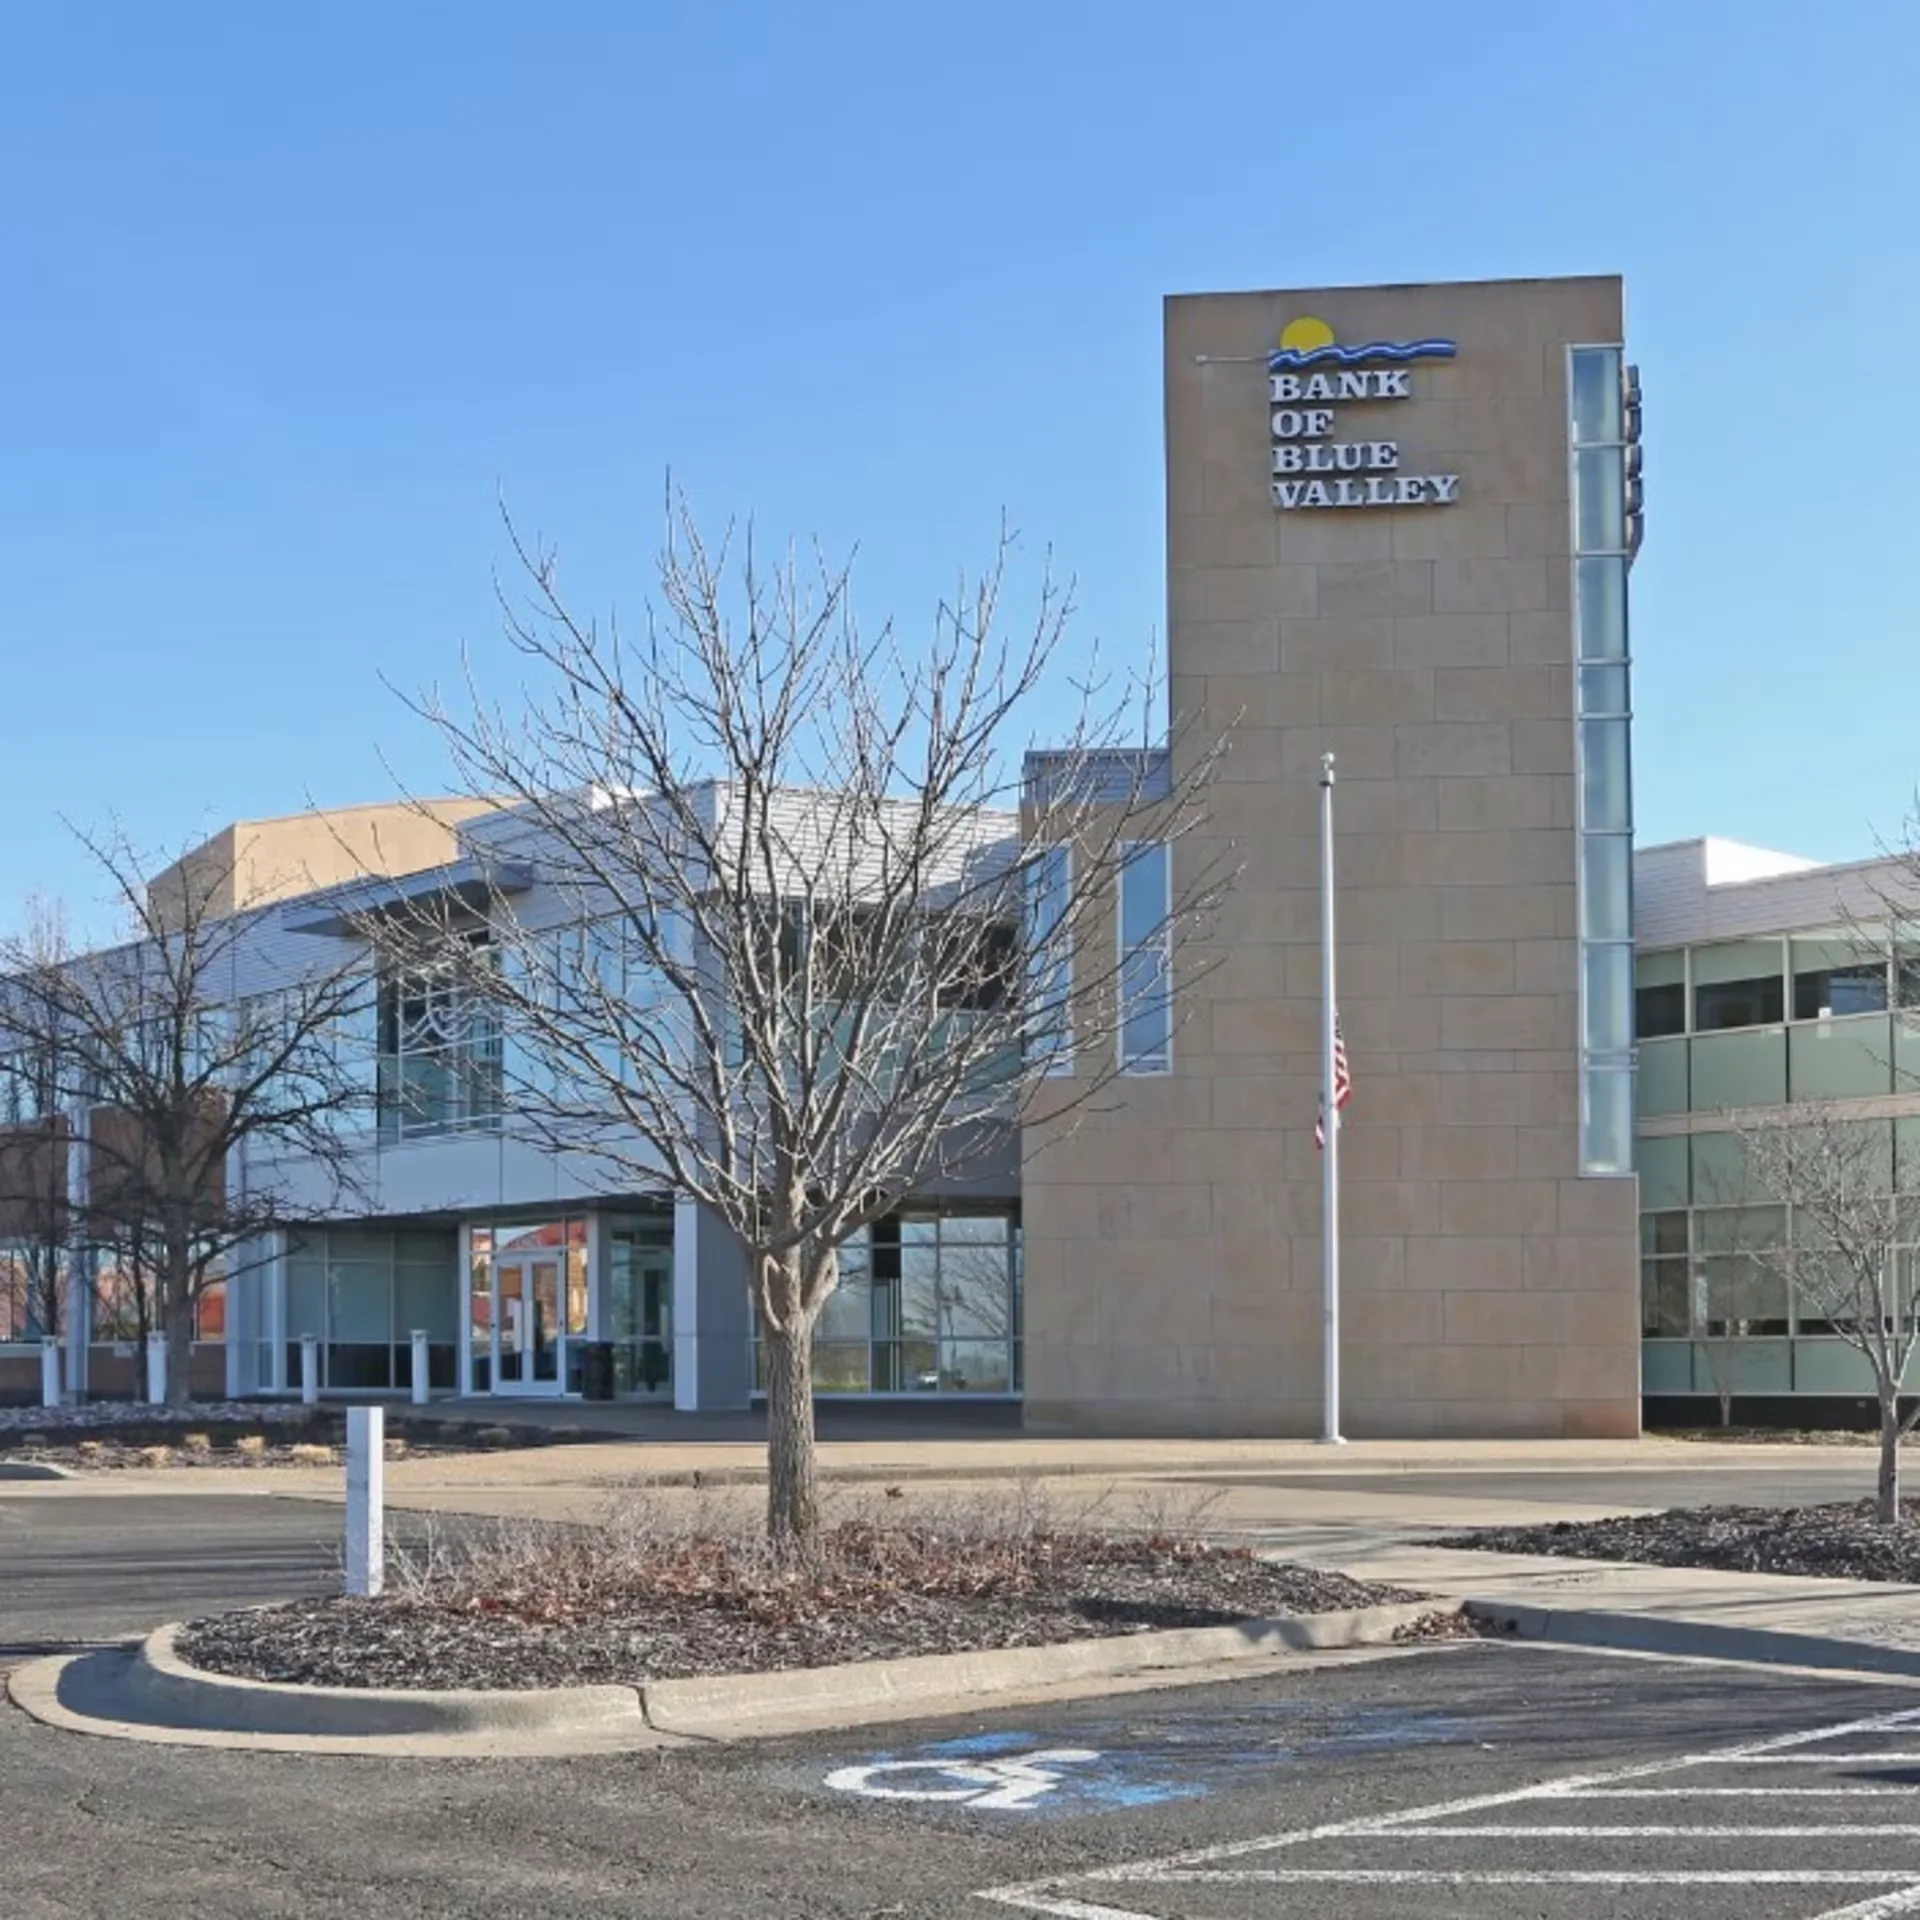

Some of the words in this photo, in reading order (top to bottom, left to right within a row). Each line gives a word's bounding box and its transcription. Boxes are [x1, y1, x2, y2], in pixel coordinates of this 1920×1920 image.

[1270, 370, 1410, 402] BANK
[1271, 409, 1334, 438] OF
[1273, 442, 1399, 474] BLUE
[1272, 475, 1459, 509] VALLEY
